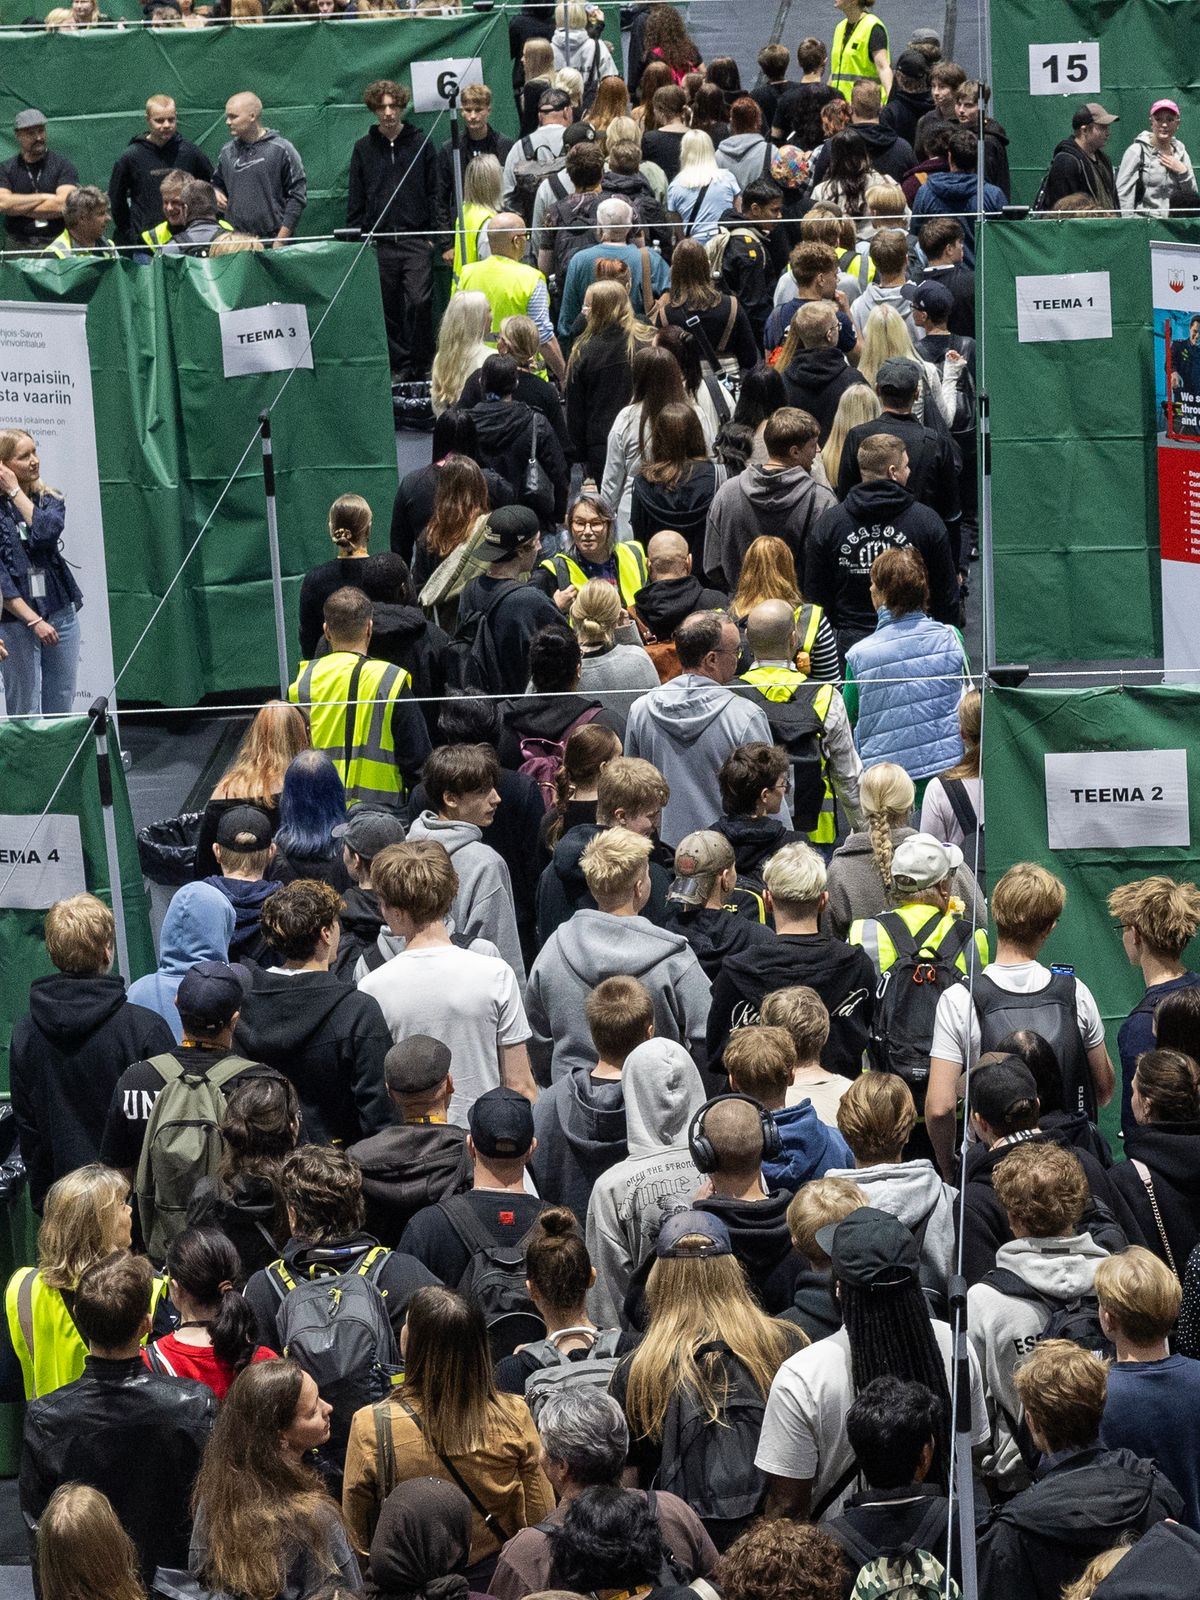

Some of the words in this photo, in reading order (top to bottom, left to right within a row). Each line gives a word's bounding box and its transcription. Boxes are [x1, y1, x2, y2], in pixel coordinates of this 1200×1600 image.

[1042, 54, 1088, 83] 15
[437, 71, 460, 100] 6
[1033, 298, 1082, 310] TEEMA
[1087, 296, 1093, 307] 1
[0, 328, 43, 339] hjois-Savon
[237, 328, 285, 344] TEEMA
[288, 327, 297, 338] 3
[1, 369, 75, 388] varpaisiin,
[23, 391, 72, 405] vaariin
[1180, 391, 1194, 402] We
[1181, 416, 1197, 426] and
[1070, 787, 1145, 803] TEEMA
[1151, 786, 1163, 801] 2
[47, 848, 60, 862] 4
